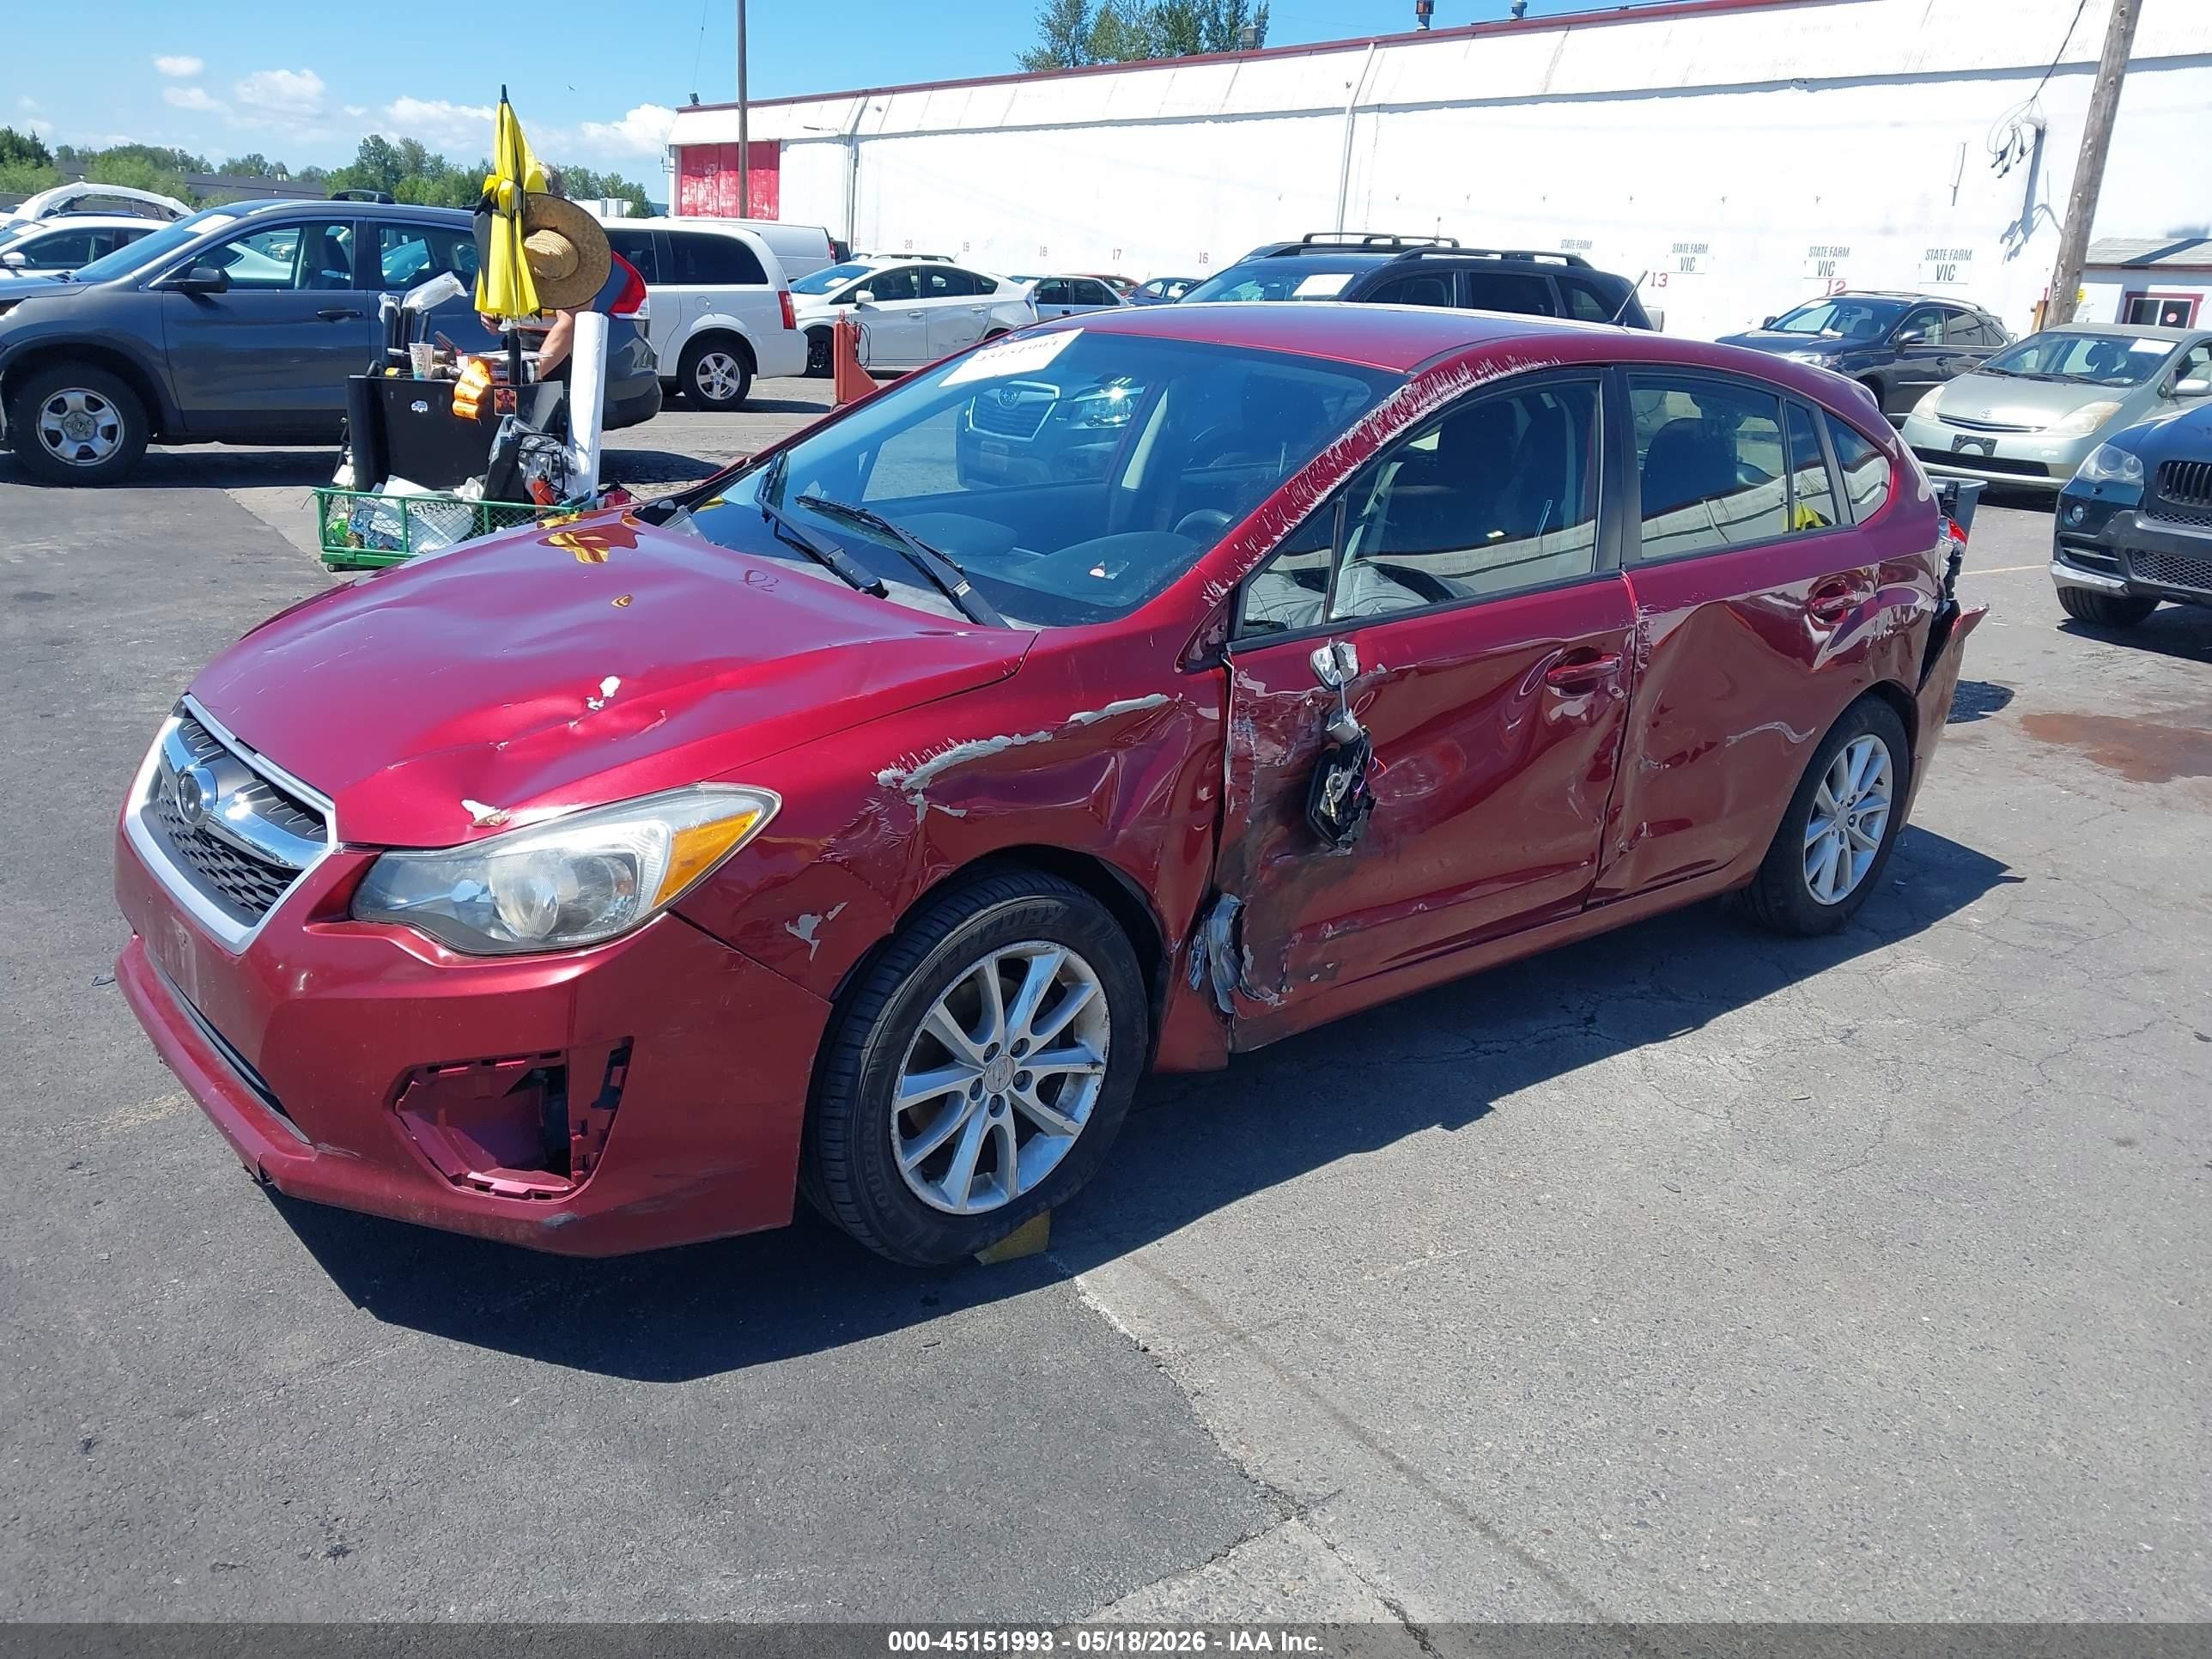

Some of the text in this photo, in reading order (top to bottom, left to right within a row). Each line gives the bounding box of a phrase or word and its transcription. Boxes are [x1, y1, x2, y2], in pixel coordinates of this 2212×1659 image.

[903, 239, 914, 250] 20
[963, 241, 970, 252] 19
[1039, 245, 1048, 257] 18
[1560, 239, 1593, 250] STATE FARM
[1672, 242, 1709, 255] STATE FARM
[1112, 248, 1122, 261] 17
[1198, 252, 1209, 264] 16
[1808, 246, 1850, 258] STATE FARM
[1925, 248, 1973, 262] STATE FARM
[1680, 257, 1697, 272] VIC
[1817, 260, 1836, 277] VIC
[1650, 271, 1668, 288] 13
[1936, 264, 1957, 282] VIC
[1826, 279, 1847, 296] 12
